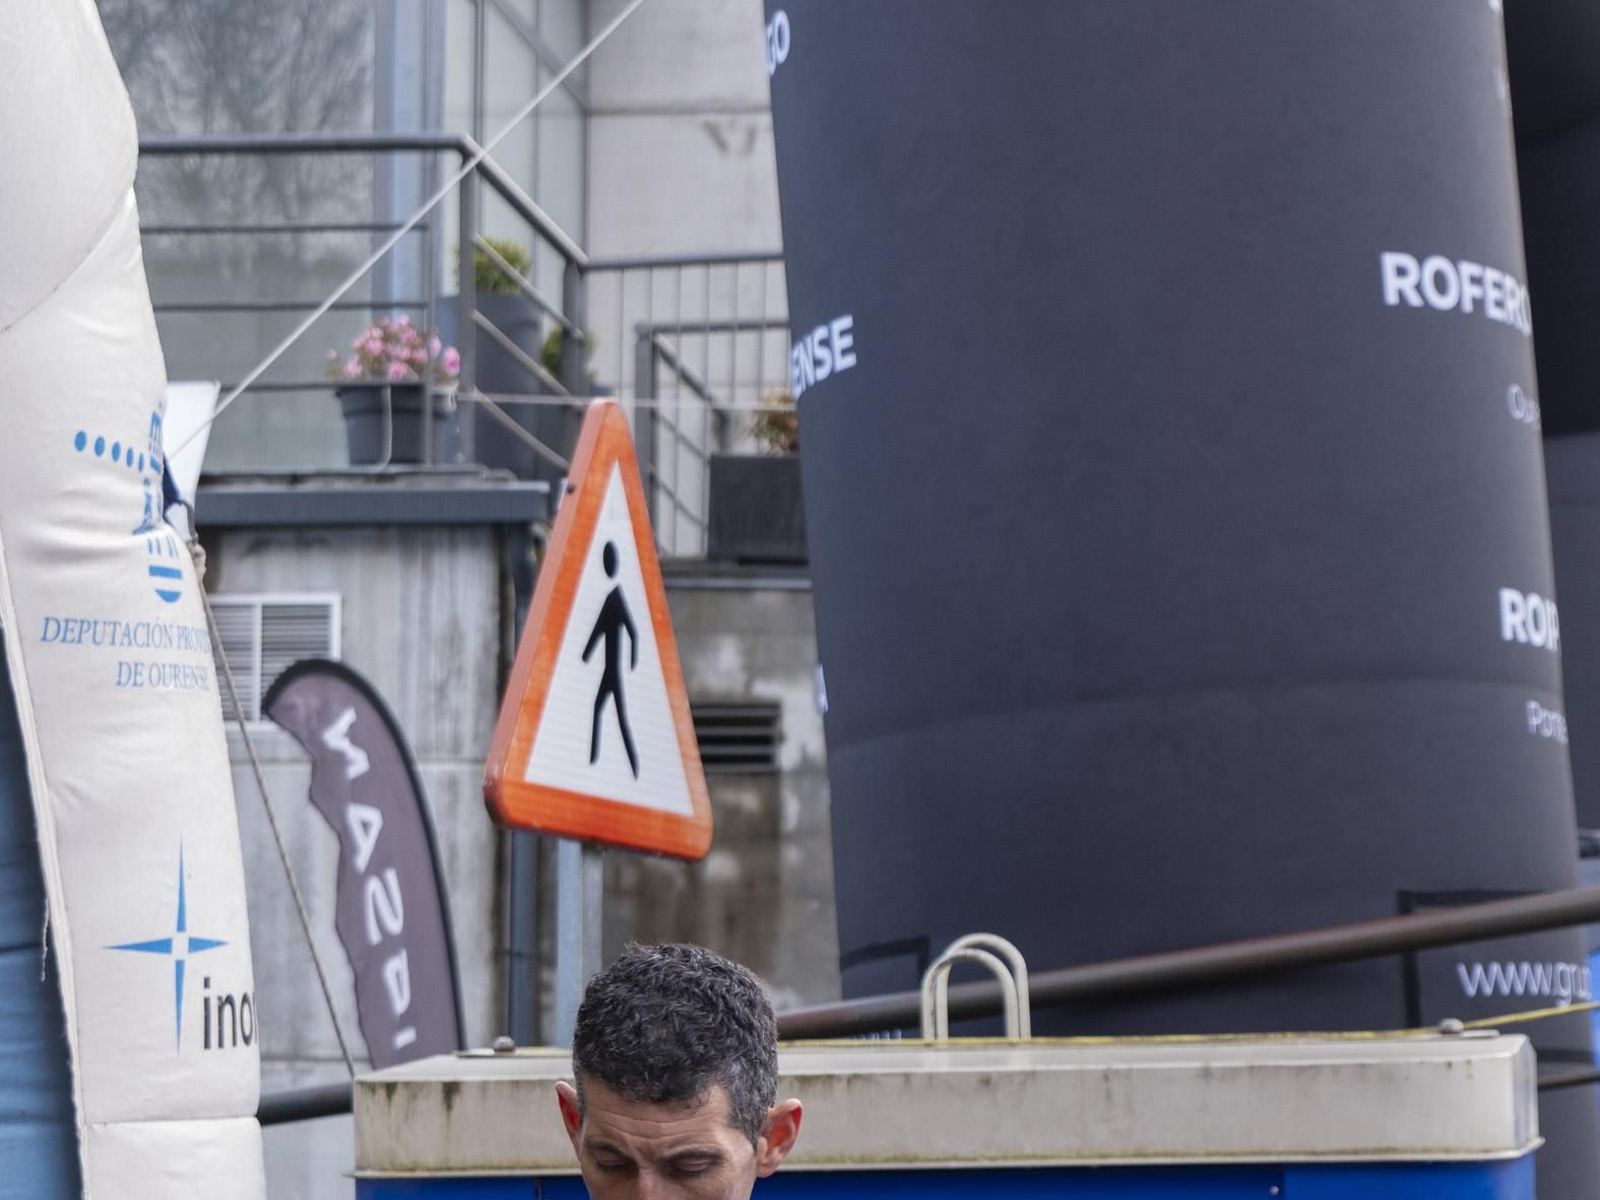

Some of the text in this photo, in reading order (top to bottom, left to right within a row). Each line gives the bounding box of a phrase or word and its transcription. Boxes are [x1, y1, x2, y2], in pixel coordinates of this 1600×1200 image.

[792, 314, 857, 400] ENSE
[40, 615, 174, 649] DEPUTACIÓN
[115, 660, 145, 687] DE
